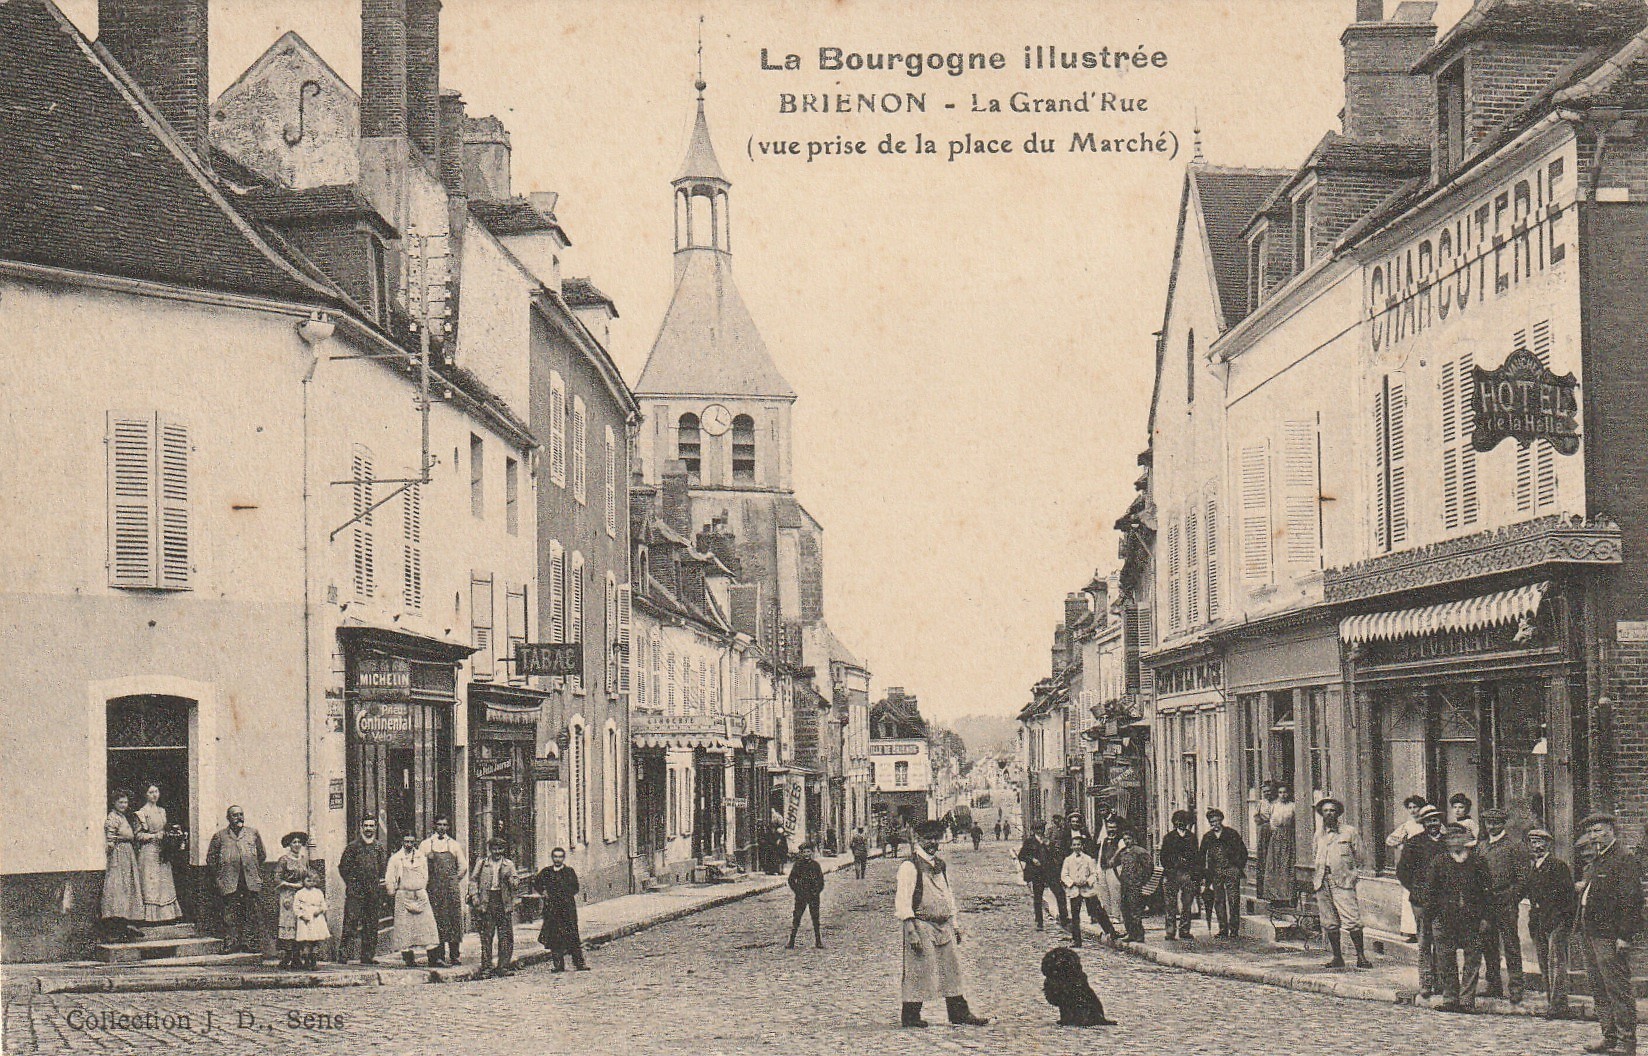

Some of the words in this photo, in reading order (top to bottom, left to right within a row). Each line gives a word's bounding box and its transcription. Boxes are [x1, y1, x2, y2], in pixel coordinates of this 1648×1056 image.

[1371, 156, 1565, 351] CHARCUTERIE
[520, 647, 576, 671] TABAC
[360, 673, 410, 687] MICHELIN
[356, 709, 412, 740] Continental
[783, 782, 802, 840] MEUBLES
